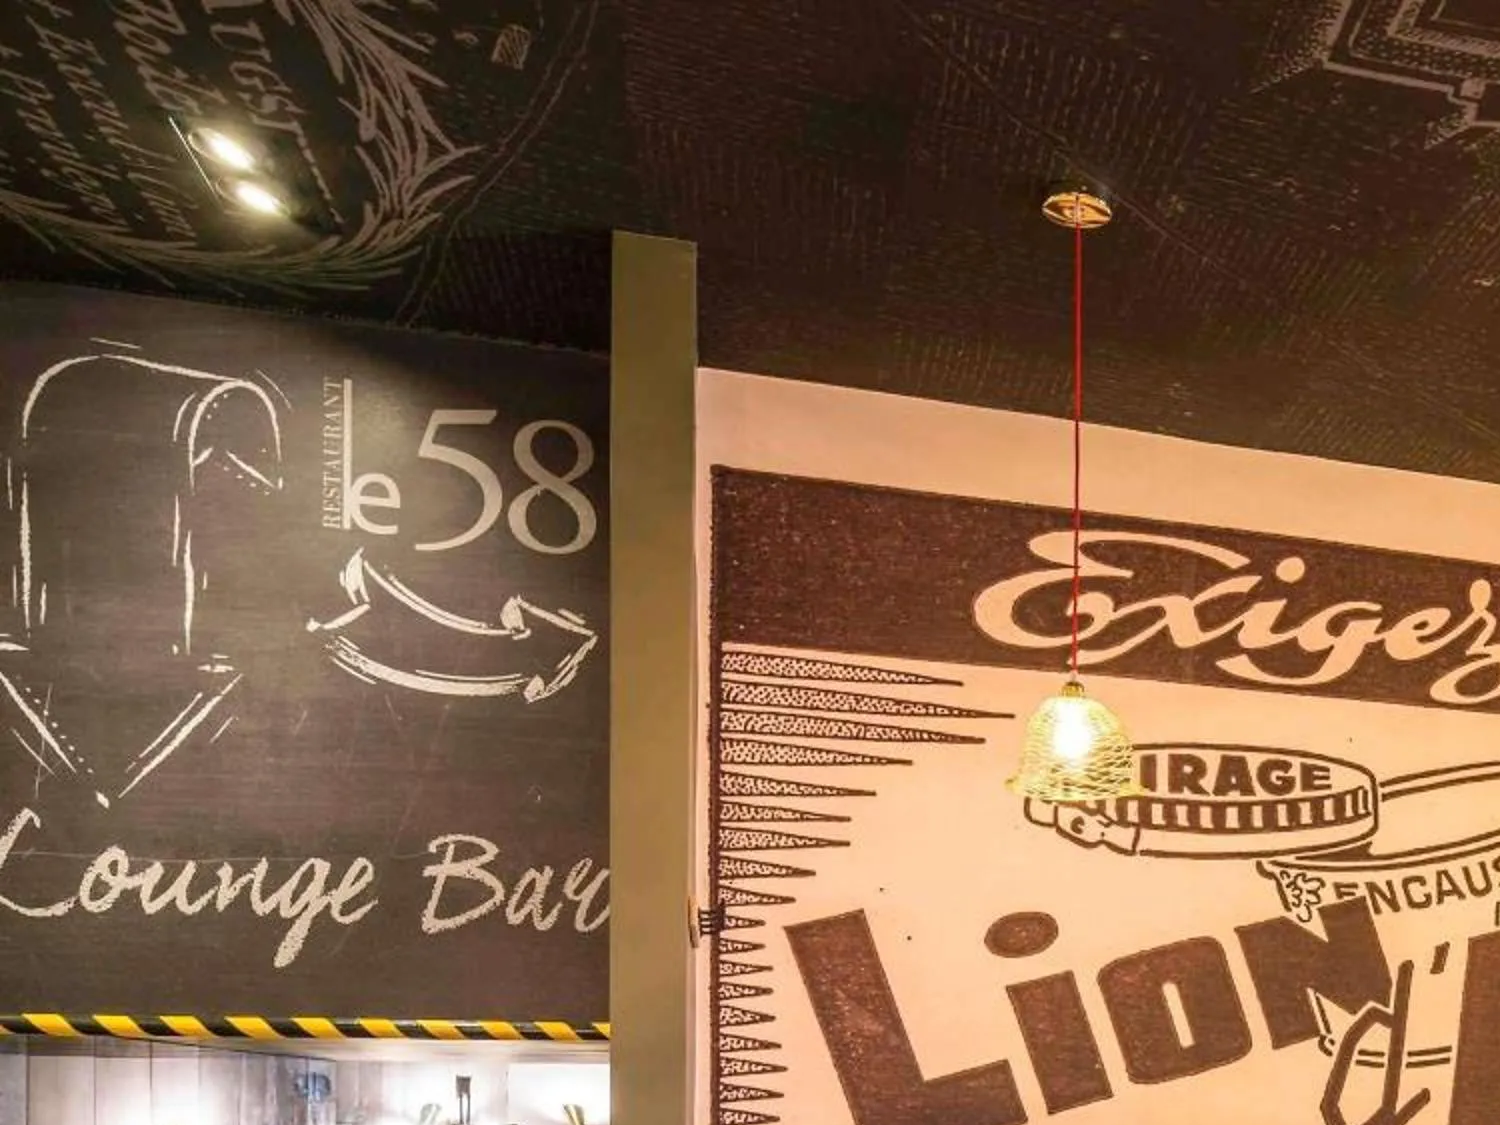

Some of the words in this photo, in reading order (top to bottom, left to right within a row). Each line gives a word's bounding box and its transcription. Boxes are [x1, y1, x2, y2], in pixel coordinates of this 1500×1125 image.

[322, 376, 343, 530] RESTAURANT
[343, 378, 401, 535] le
[414, 409, 597, 554] 58
[1138, 753, 1333, 797] IRAGE
[0, 807, 378, 968] Lounge
[421, 833, 609, 935] Bar
